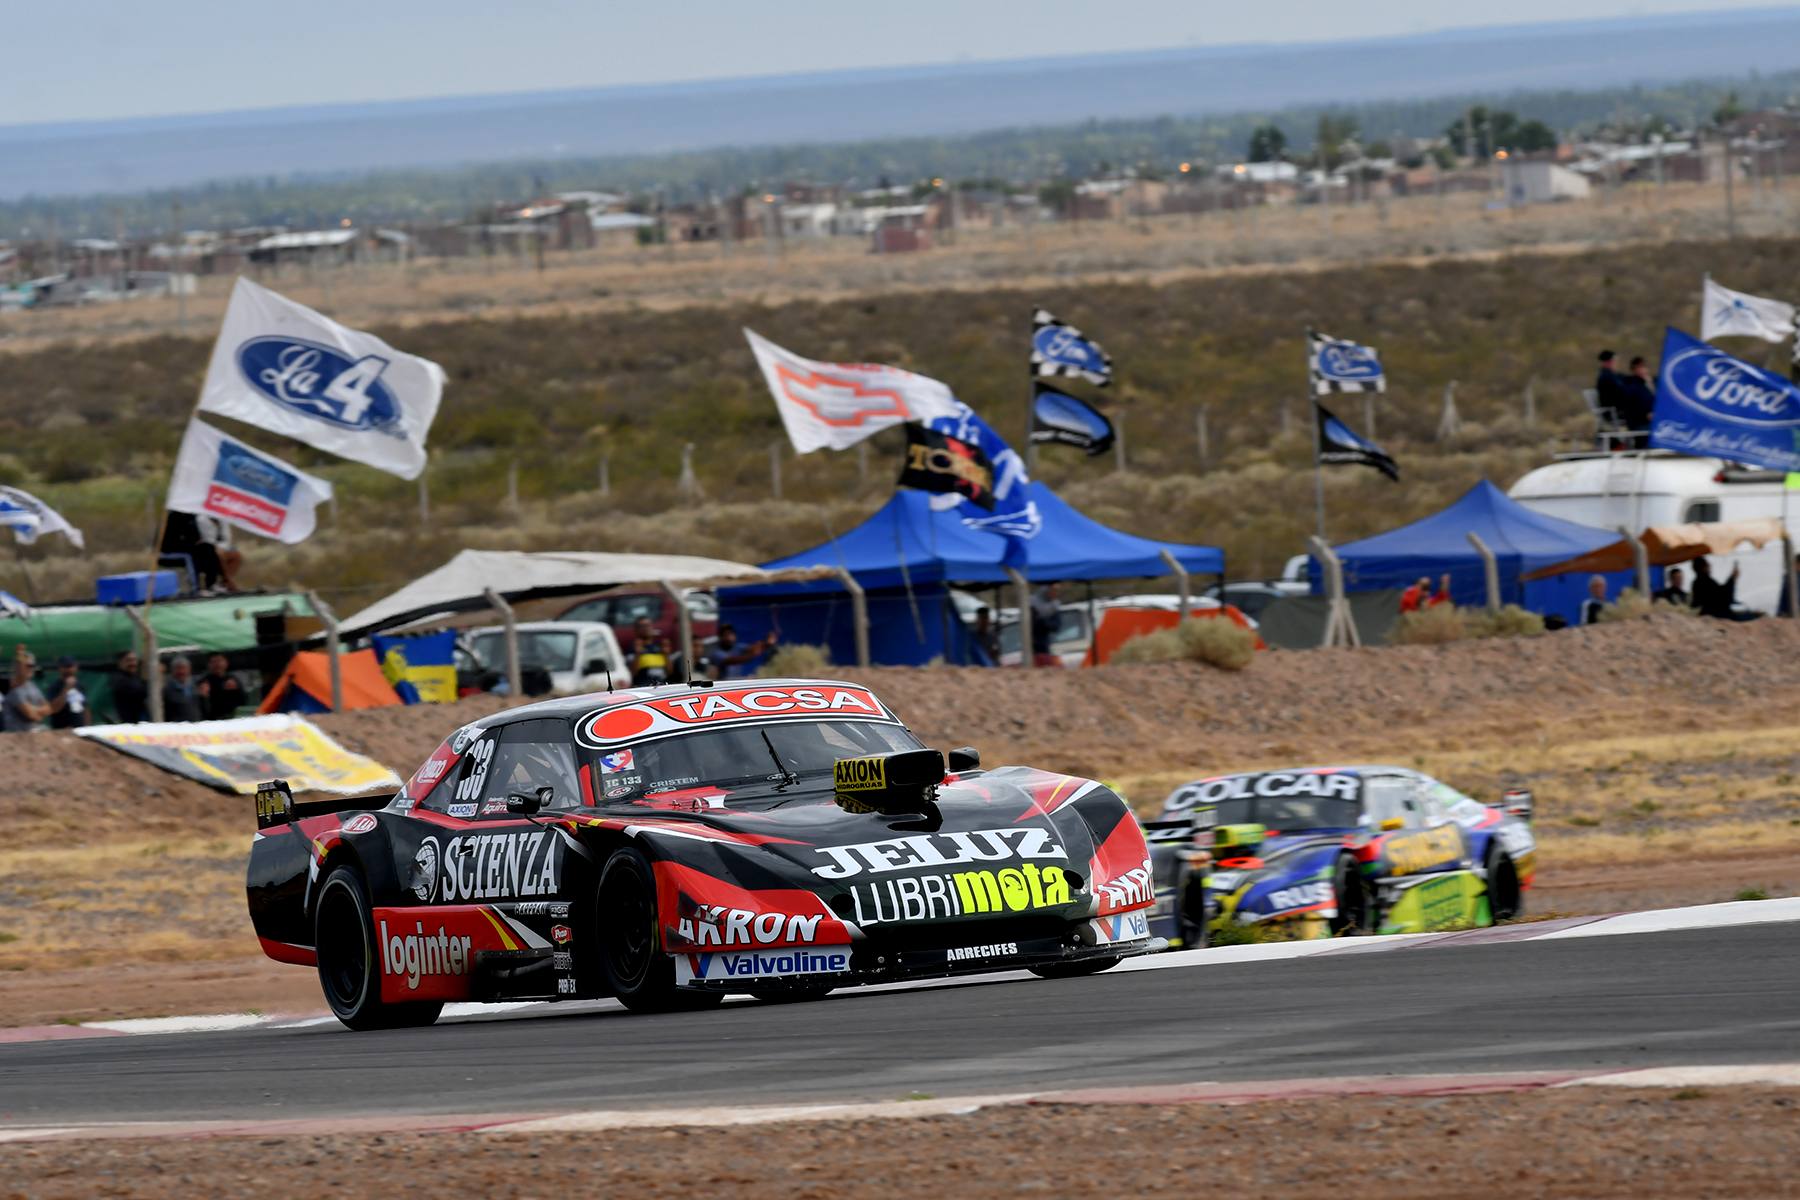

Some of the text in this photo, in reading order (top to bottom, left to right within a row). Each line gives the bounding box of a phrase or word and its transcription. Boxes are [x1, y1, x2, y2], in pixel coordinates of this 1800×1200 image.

[259, 345, 392, 426] La 4
[1695, 357, 1789, 415] Ford
[668, 690, 877, 720] TACSA
[623, 775, 642, 785] 133
[649, 776, 699, 788] CRISTEM
[837, 759, 883, 783] AXION
[1164, 774, 1361, 811] COLCAR
[450, 804, 472, 815] AXION
[442, 831, 558, 902] SCIENZA
[810, 827, 1069, 880] JELUZ
[379, 920, 472, 990] loginter
[721, 951, 846, 976] Valvoline
[946, 942, 1019, 962] ARRECIFES
